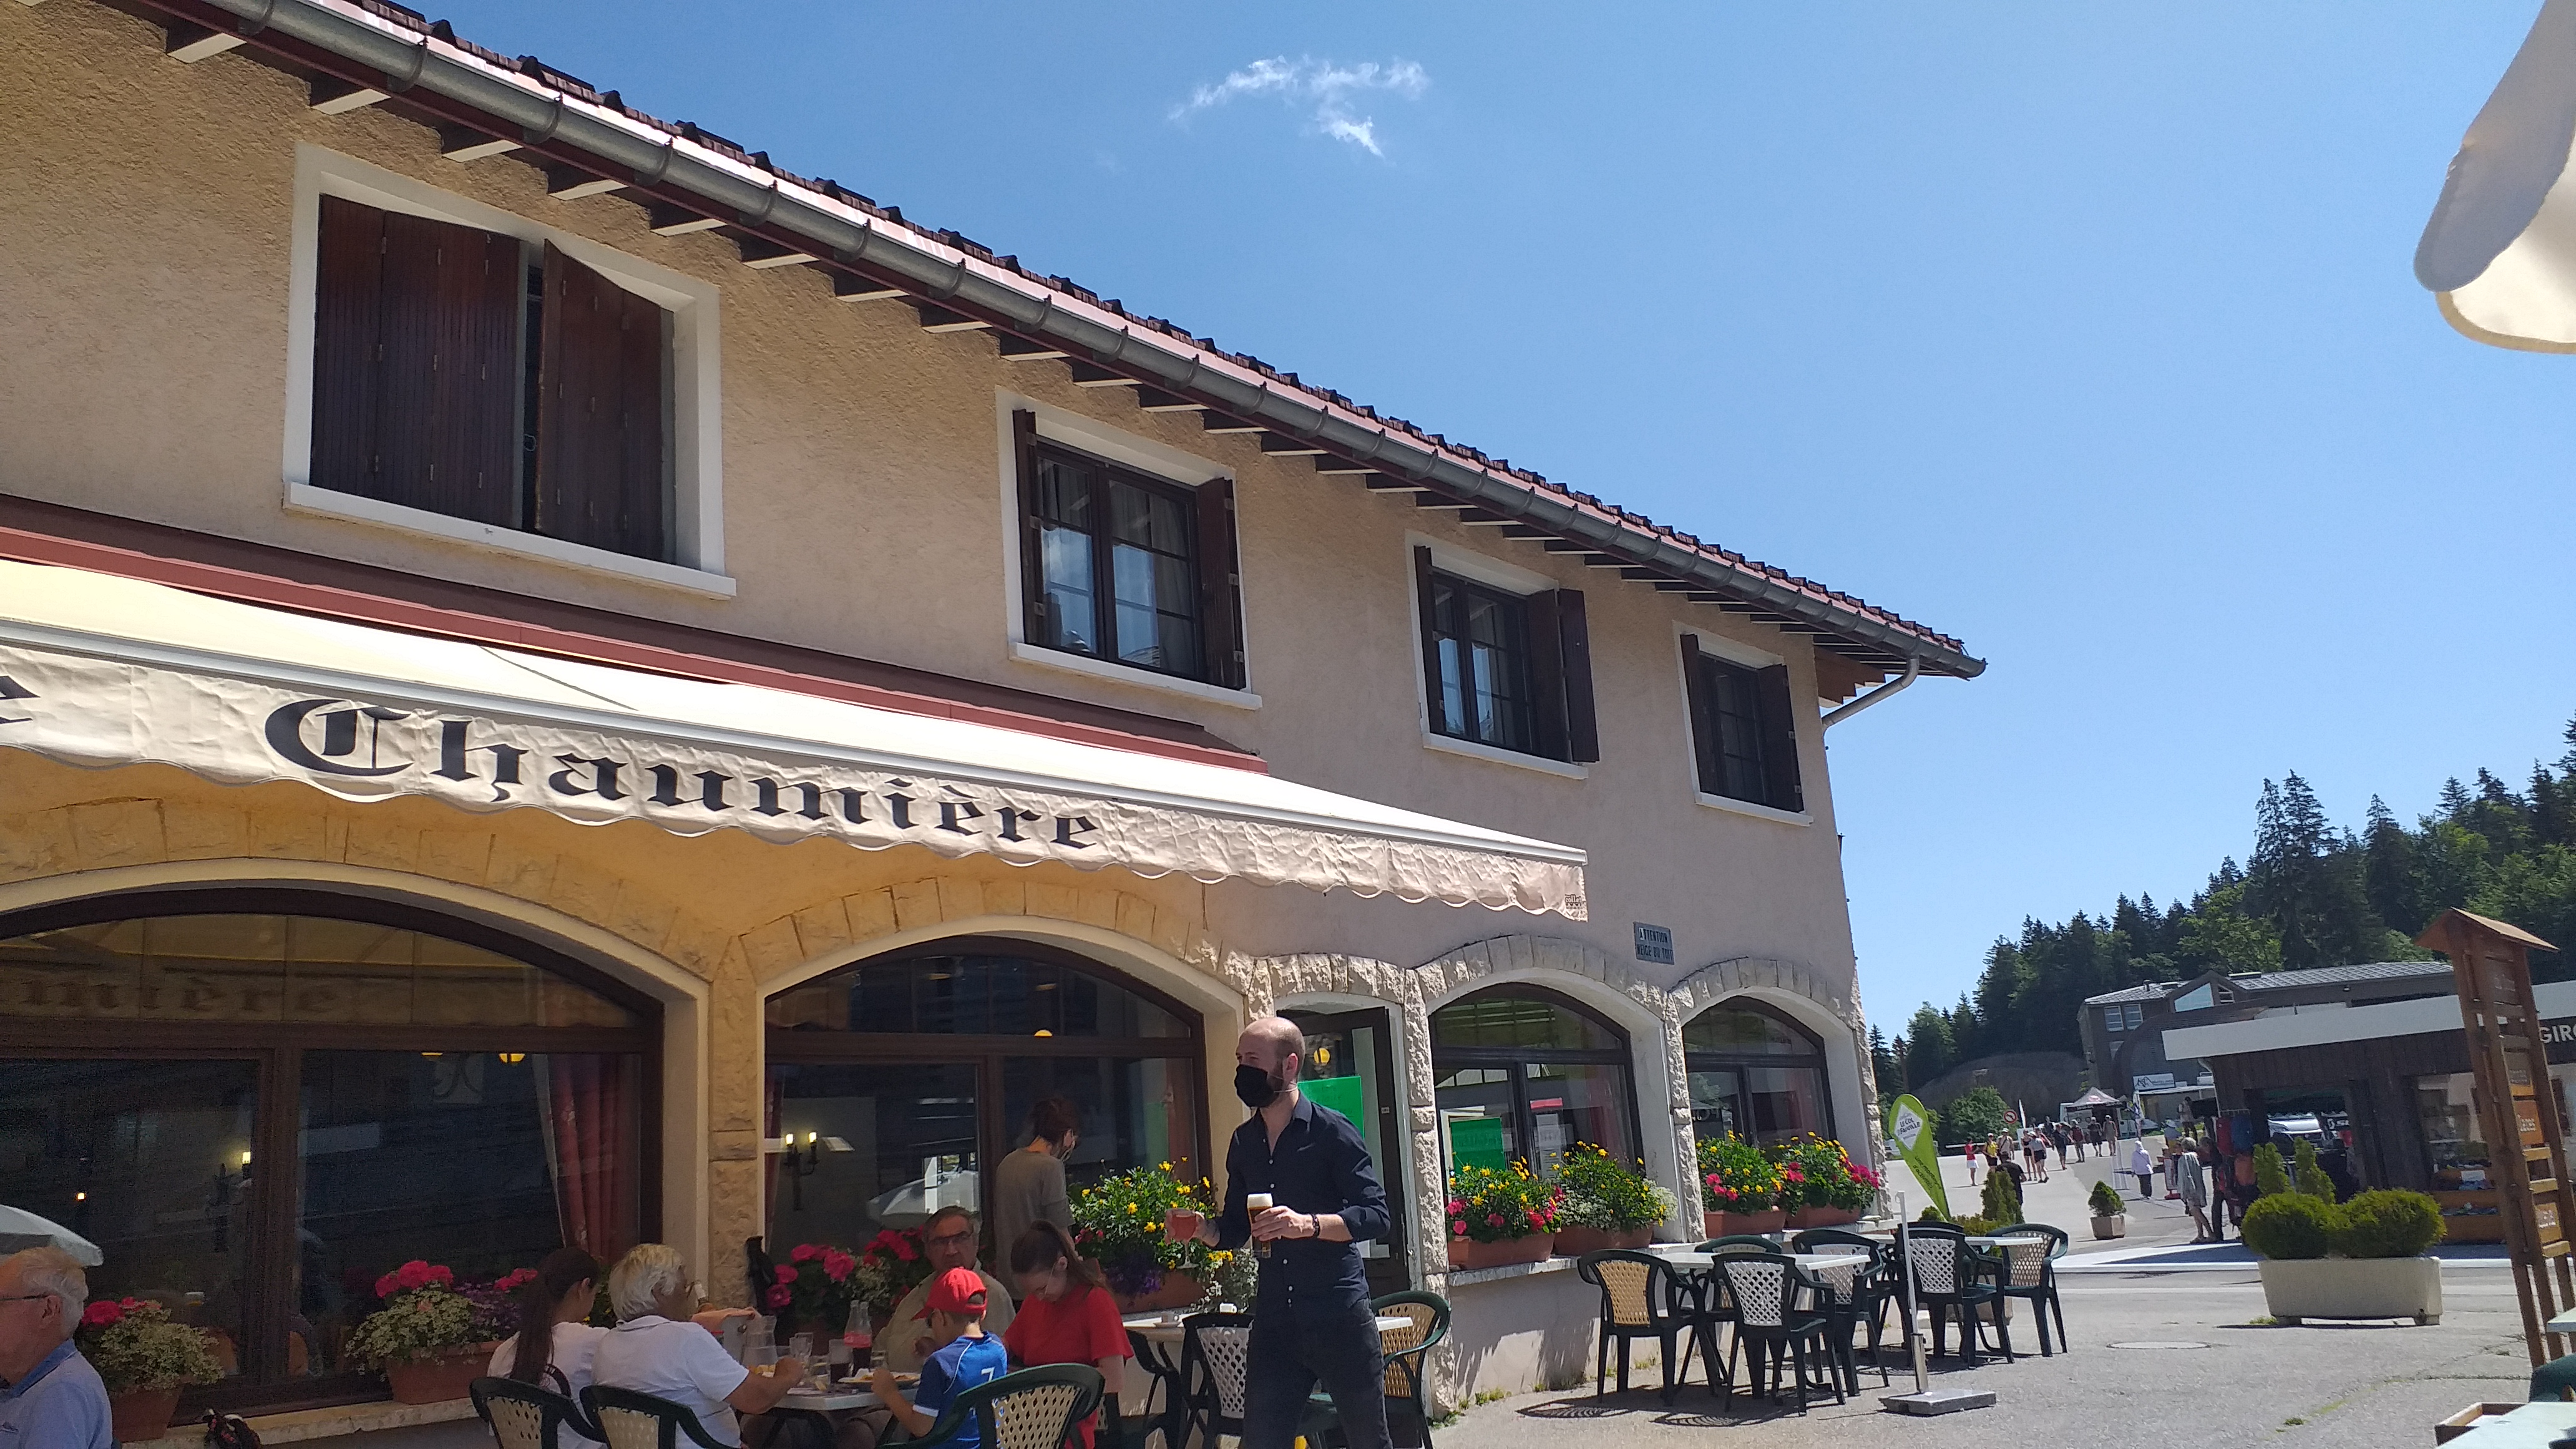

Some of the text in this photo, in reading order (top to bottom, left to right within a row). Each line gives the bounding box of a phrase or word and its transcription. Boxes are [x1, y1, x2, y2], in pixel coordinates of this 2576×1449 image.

[265, 698, 1098, 849] Chaumière
[1639, 928, 1668, 943] ATTENTION
[1636, 944, 1674, 961] NEIGE DU TOIT
[2539, 1023, 2576, 1043] GIR
